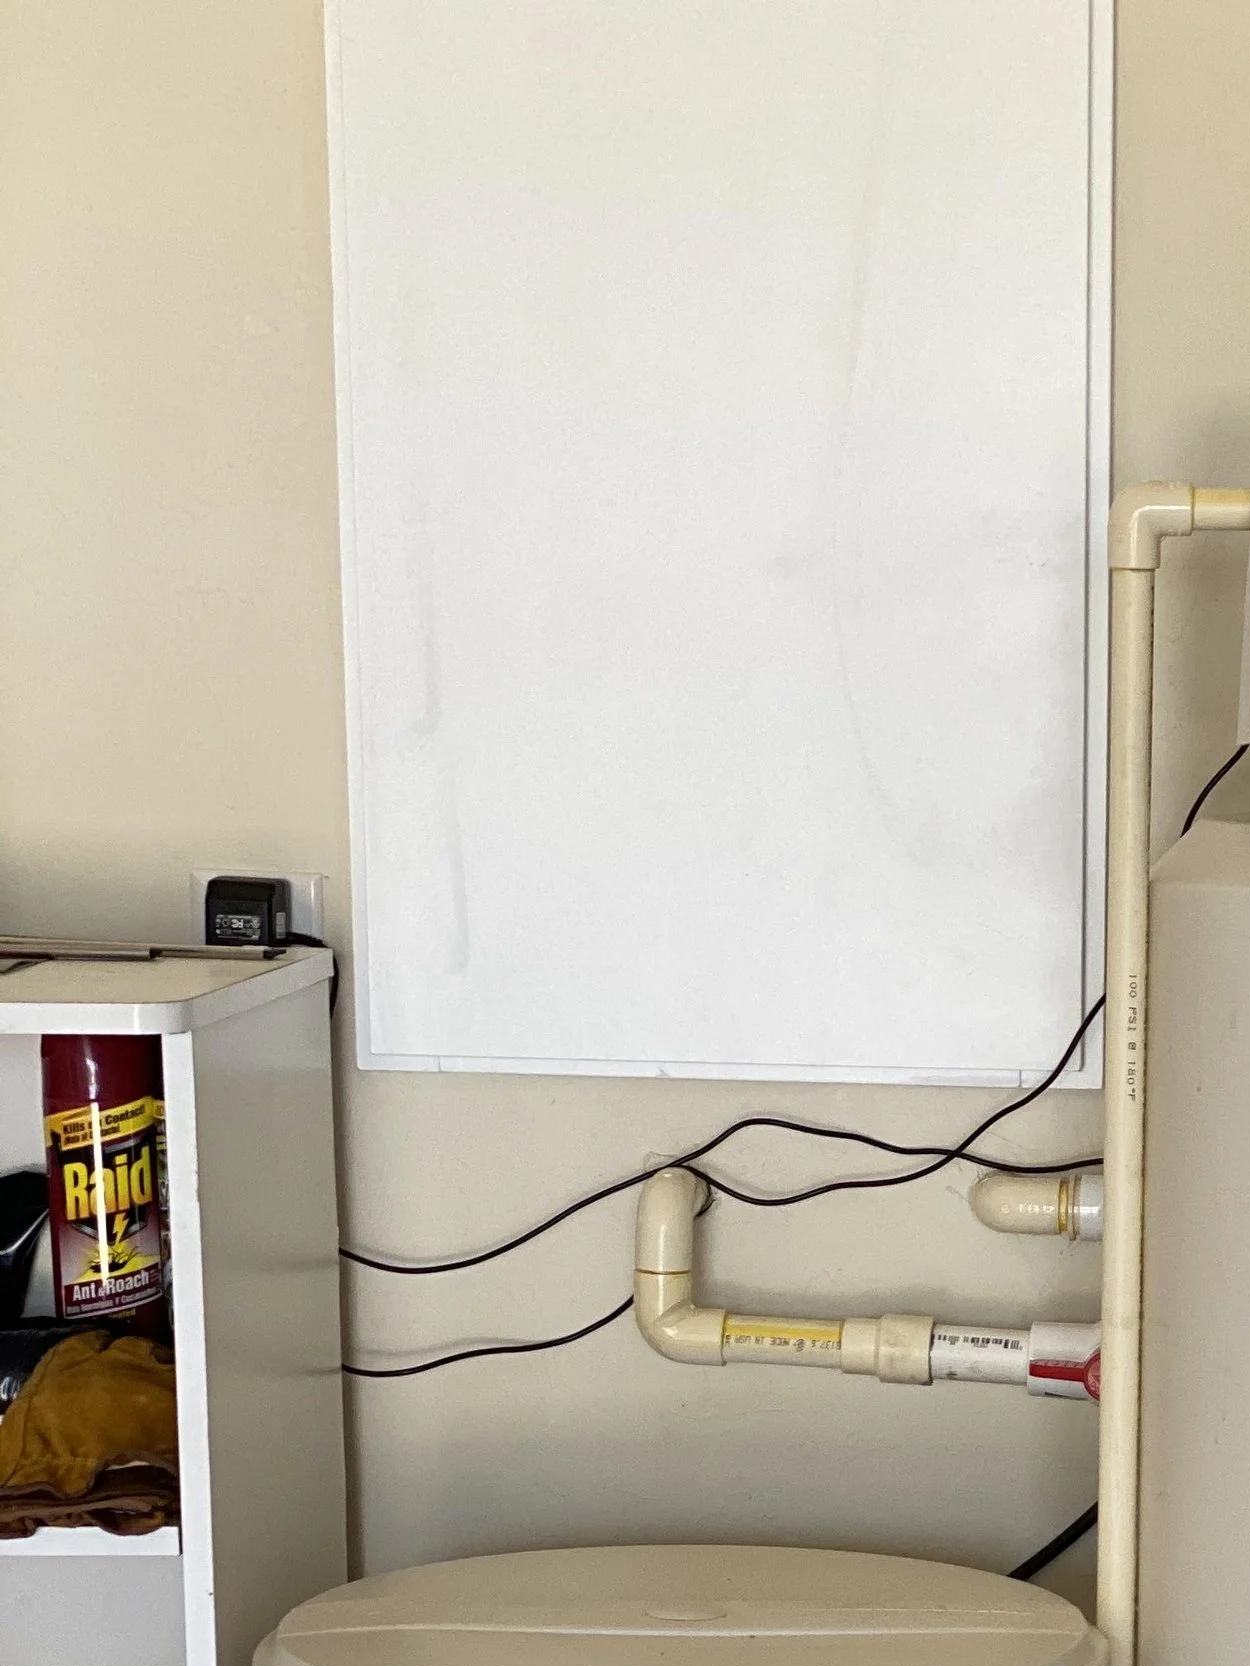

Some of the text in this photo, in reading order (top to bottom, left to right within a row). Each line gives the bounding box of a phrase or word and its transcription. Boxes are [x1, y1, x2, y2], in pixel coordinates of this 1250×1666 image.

[1128, 974, 1138, 998] 100
[1127, 1006, 1138, 1032] PSI
[63, 1121, 85, 1135] Kills
[63, 1144, 153, 1222] Raid
[72, 1282, 96, 1301] Ant
[105, 1270, 150, 1296] Roach
